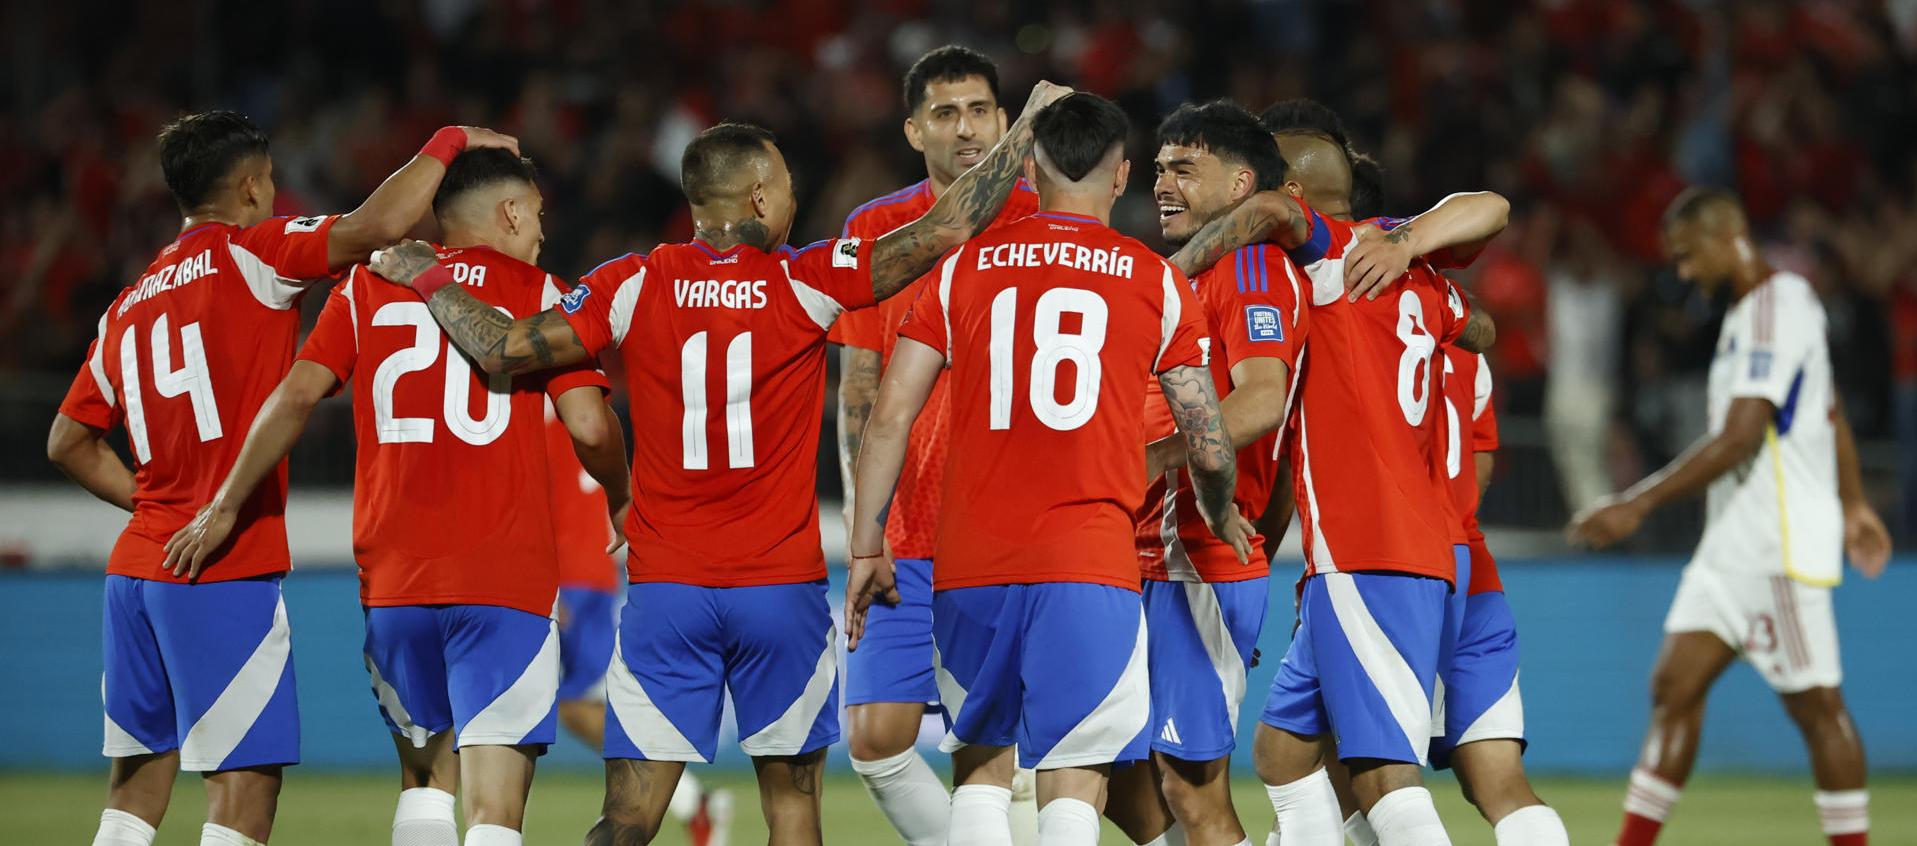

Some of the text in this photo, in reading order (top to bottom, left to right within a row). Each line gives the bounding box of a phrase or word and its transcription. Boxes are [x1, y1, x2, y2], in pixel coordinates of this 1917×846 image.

[674, 279, 767, 309] VARGAS
[977, 242, 1134, 279] ECHEVERRÍA
[120, 312, 223, 465] 14
[371, 301, 514, 446] 20
[681, 331, 754, 470] 11
[989, 286, 1108, 431] 18
[1397, 289, 1435, 426] 8
